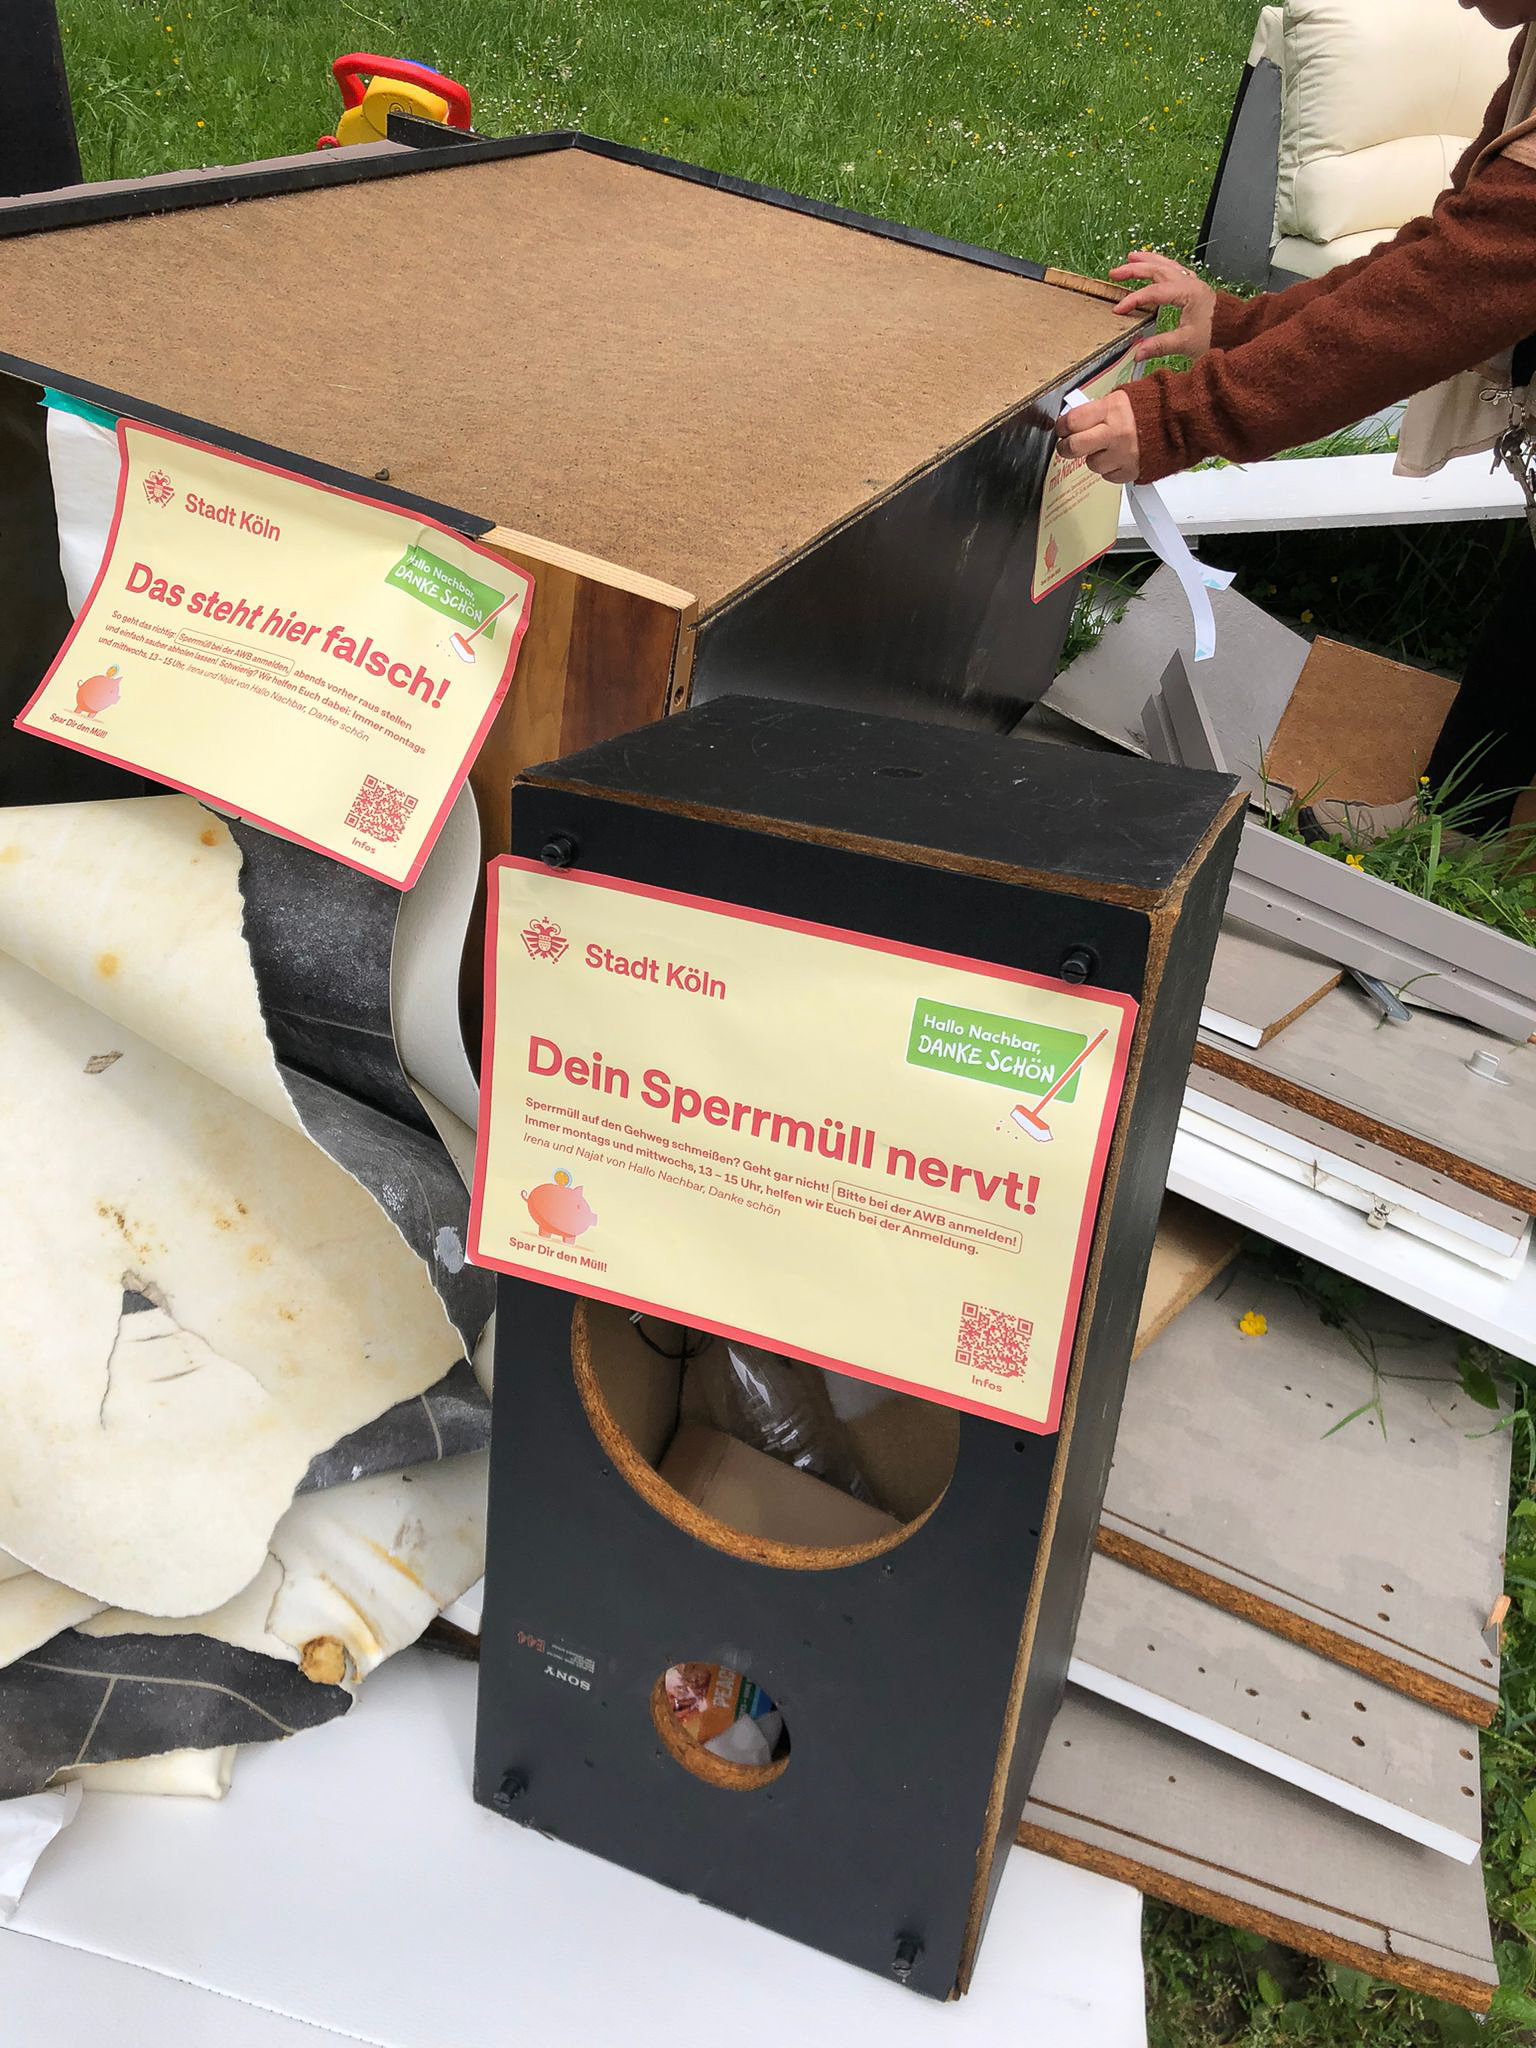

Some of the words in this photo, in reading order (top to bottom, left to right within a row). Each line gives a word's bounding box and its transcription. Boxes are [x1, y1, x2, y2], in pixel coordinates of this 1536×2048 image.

[184, 492, 237, 527] Stadt
[239, 510, 281, 542] Köln
[394, 565, 440, 598] DANKE
[440, 589, 482, 622] SCHÖN
[406, 553, 430, 574] Hallo
[432, 566, 475, 602] Nachbar,
[124, 561, 186, 607] Das
[186, 591, 265, 630] steht
[258, 607, 321, 646] hier
[320, 625, 452, 709] falsch!
[98, 636, 114, 647] und
[111, 641, 148, 659] mittwochs,
[148, 652, 160, 662] 13
[162, 656, 174, 666] 15
[171, 659, 186, 671] Uhr,
[186, 663, 205, 676] Irena
[204, 668, 219, 680] und
[217, 674, 238, 687] Najat
[236, 680, 251, 690] von
[249, 683, 271, 697] Hallo
[269, 691, 307, 714] Nachbar,
[307, 706, 340, 727] Danke
[339, 723, 370, 742] schön
[105, 624, 121, 634] und
[119, 628, 145, 643] einfach
[144, 638, 169, 650] sauber
[168, 644, 194, 659] abholen
[194, 652, 219, 666] lassen!
[219, 660, 258, 678] Schwierig?
[258, 670, 273, 682] Wir
[271, 675, 298, 692] helfen
[297, 685, 321, 702] Euch
[321, 697, 352, 716] dabei:
[351, 710, 385, 732] Immer
[383, 728, 426, 755] montags
[111, 610, 123, 620] So
[121, 615, 140, 626] geht
[138, 620, 153, 631] das
[151, 624, 177, 641] richtig:
[179, 632, 213, 648] Sperrmüll
[210, 642, 224, 652] bei
[221, 646, 235, 655] der
[233, 649, 254, 661] AWB
[251, 656, 289, 674] anmelden,
[293, 669, 327, 688] abends
[327, 682, 359, 702] vorher
[358, 698, 380, 713] raus
[380, 709, 412, 731] stellen
[351, 836, 376, 854] Infos
[585, 944, 660, 984] Stadt
[665, 962, 726, 1000] Köln
[917, 1034, 982, 1065] DANKE
[984, 1049, 1055, 1086] SCHÖN
[923, 1013, 965, 1036] Hallo
[968, 1024, 1041, 1055] Nachbar,
[528, 1036, 630, 1099] Dein
[640, 1068, 876, 1169] Sperrmüll
[886, 1146, 1041, 1216] nervt!
[523, 1132, 550, 1148] Irena
[552, 1142, 575, 1154] und
[575, 1146, 604, 1163] Najat
[606, 1157, 626, 1169] von
[628, 1161, 656, 1177] Hallo
[658, 1170, 705, 1194] Nachbar,
[708, 1185, 744, 1205] Danke
[746, 1200, 781, 1216] schön
[525, 1096, 580, 1120] Sperrmüll
[581, 1114, 600, 1125] auf
[601, 1118, 622, 1132] den
[624, 1124, 670, 1149] Gehweg
[671, 1140, 741, 1168] schmeißen?
[742, 1160, 772, 1177] Geht
[773, 1171, 794, 1183] gar
[795, 1176, 830, 1194] nicht!
[835, 1186, 867, 1206] Bitte
[868, 1196, 888, 1210] bei
[890, 1203, 912, 1217] der
[912, 1209, 946, 1226] AWB
[948, 1221, 1017, 1247] anmelden!
[525, 1114, 561, 1132] Immer
[562, 1126, 611, 1147] montags
[612, 1140, 634, 1153] und
[635, 1147, 697, 1174] mittwochs,
[698, 1164, 713, 1177] 13
[724, 1173, 738, 1185] 15
[740, 1177, 764, 1195] Uhr,
[765, 1184, 803, 1204] helfen
[804, 1198, 824, 1210] wir
[826, 1202, 856, 1220] Euch
[859, 1210, 877, 1226] bei
[880, 1216, 901, 1232] der
[902, 1225, 979, 1256] Anmeldung.
[508, 1236, 536, 1252] Spar
[537, 1244, 556, 1258] Dir
[556, 1250, 578, 1264] den
[579, 1256, 608, 1273] Müll!
[971, 1374, 1002, 1393] Infos
[544, 1666, 590, 1691] SONY
